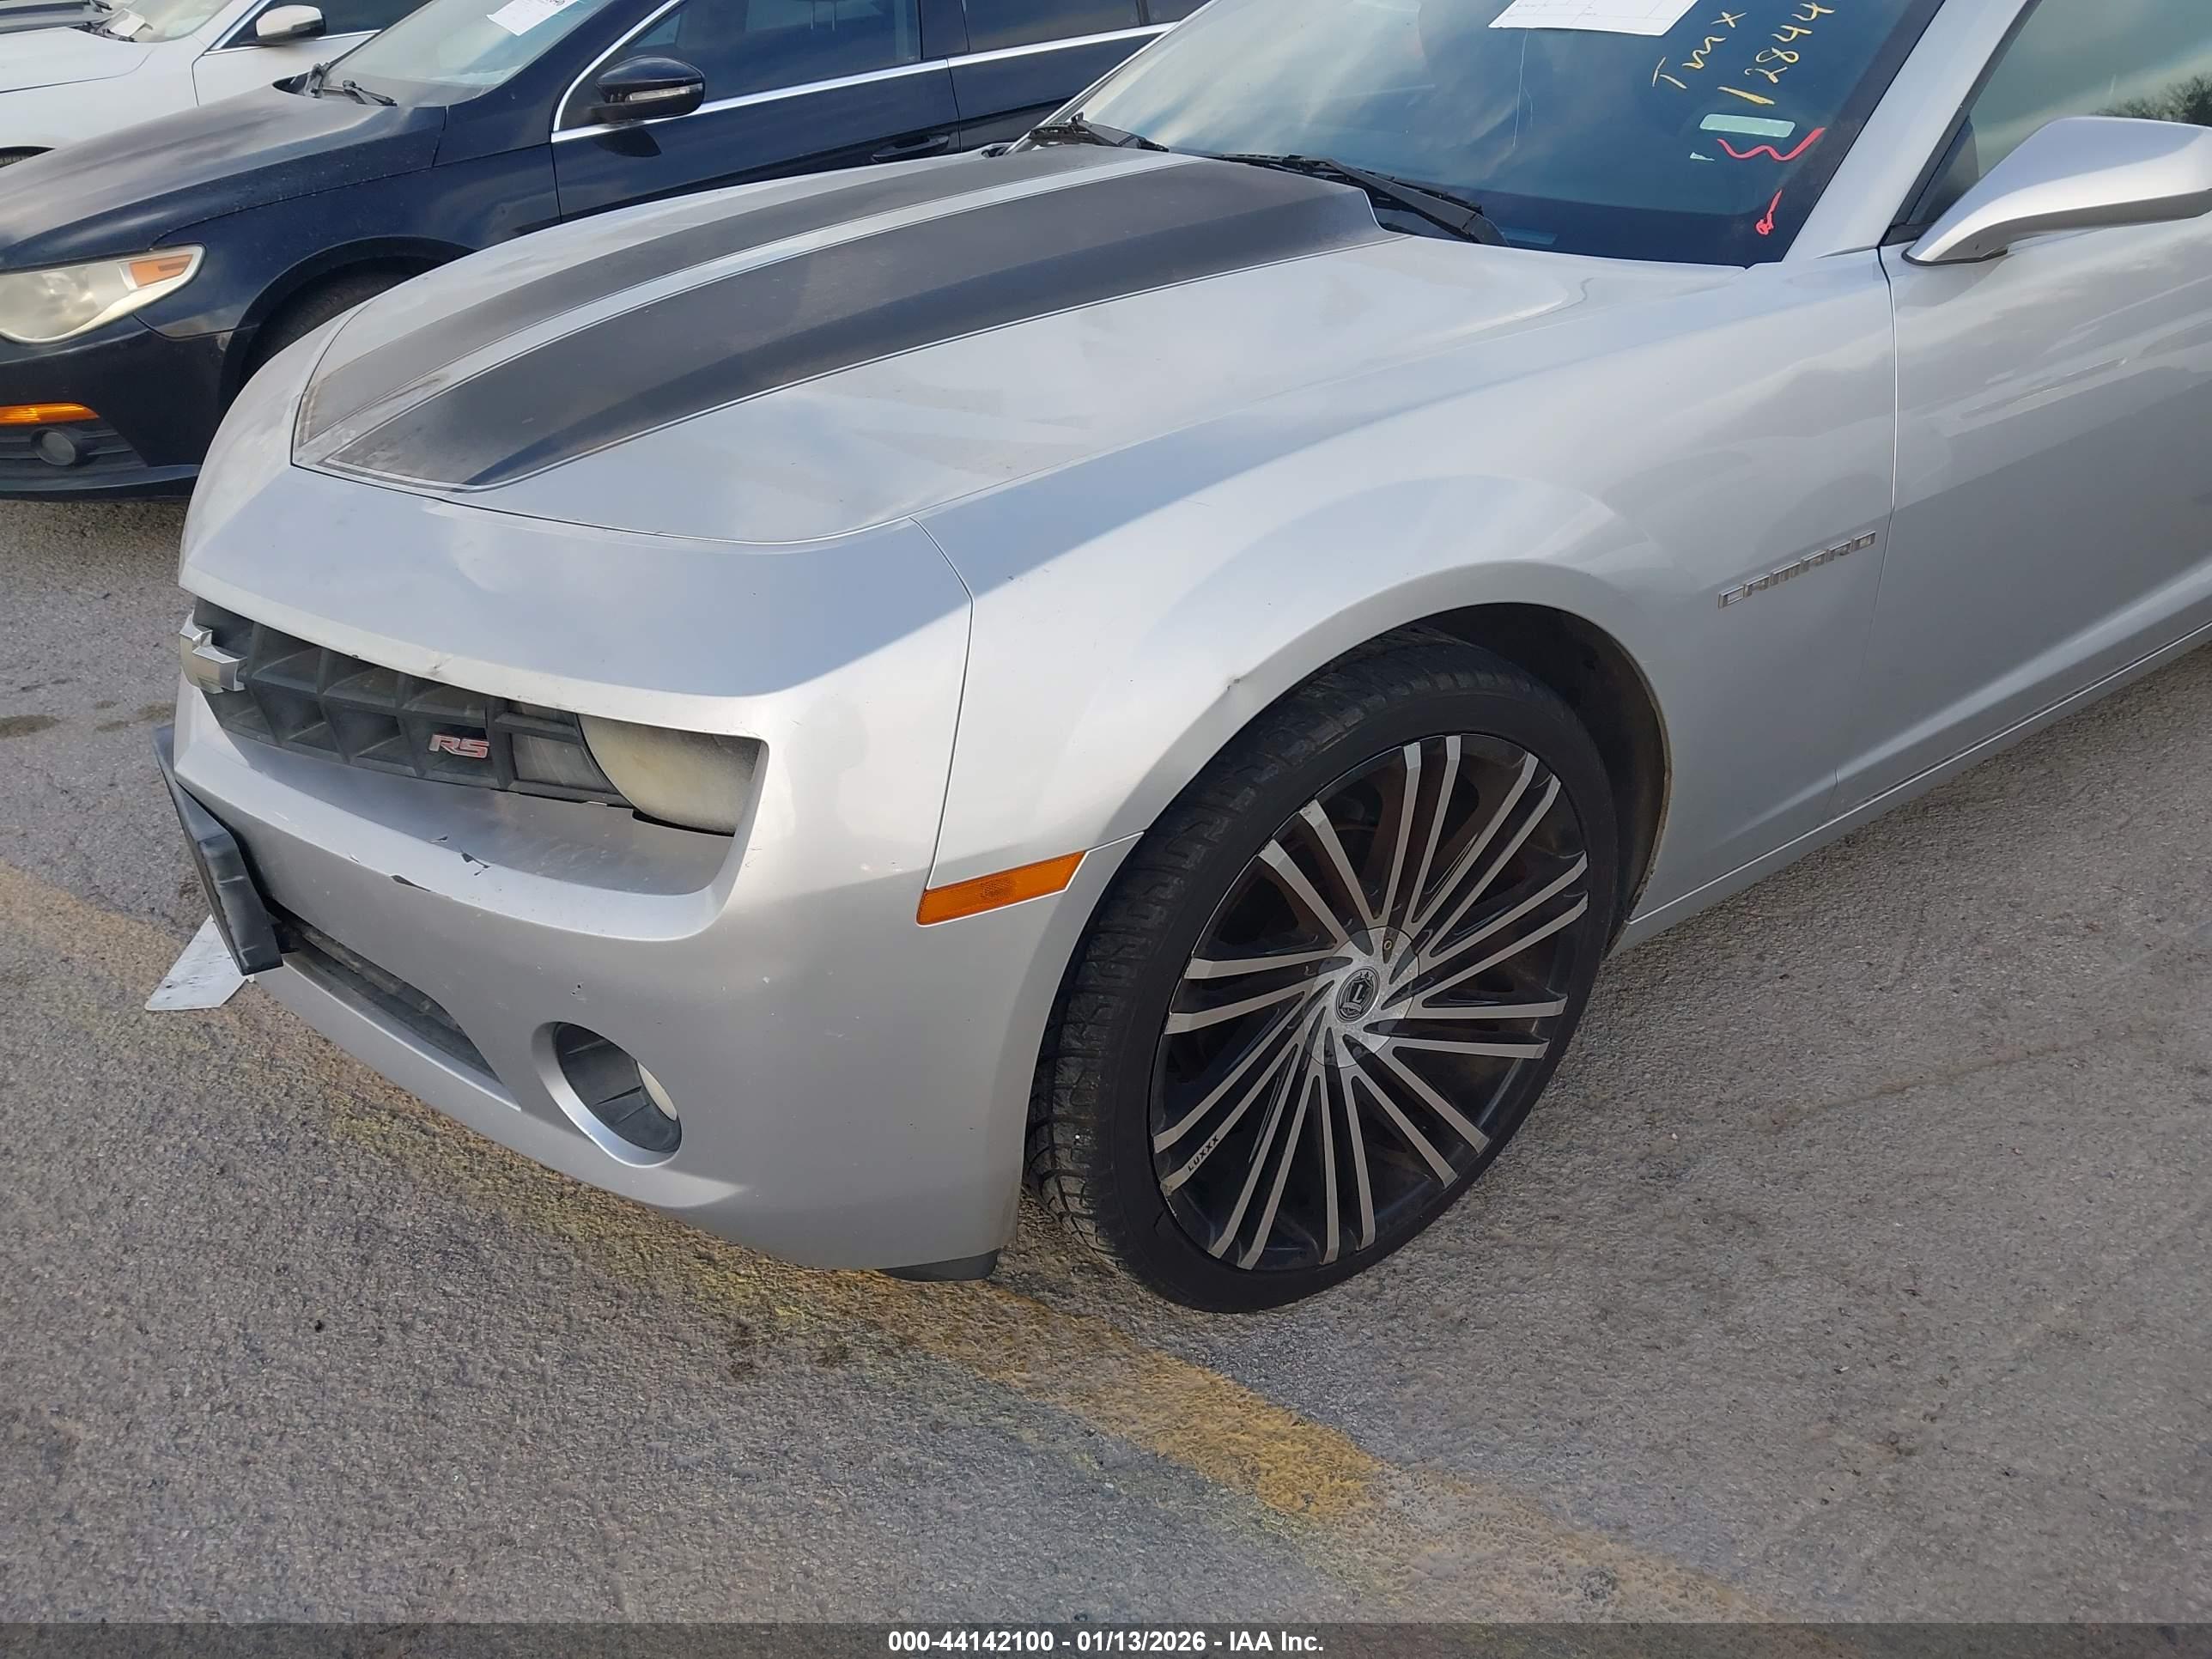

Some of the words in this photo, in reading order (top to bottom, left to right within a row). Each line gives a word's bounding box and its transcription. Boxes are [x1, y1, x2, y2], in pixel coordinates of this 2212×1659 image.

[1717, 2, 1835, 105] 12844
[1717, 529, 1876, 609] CAMARO
[428, 734, 490, 759] RS
[1188, 1134, 1219, 1172] LUXXX
